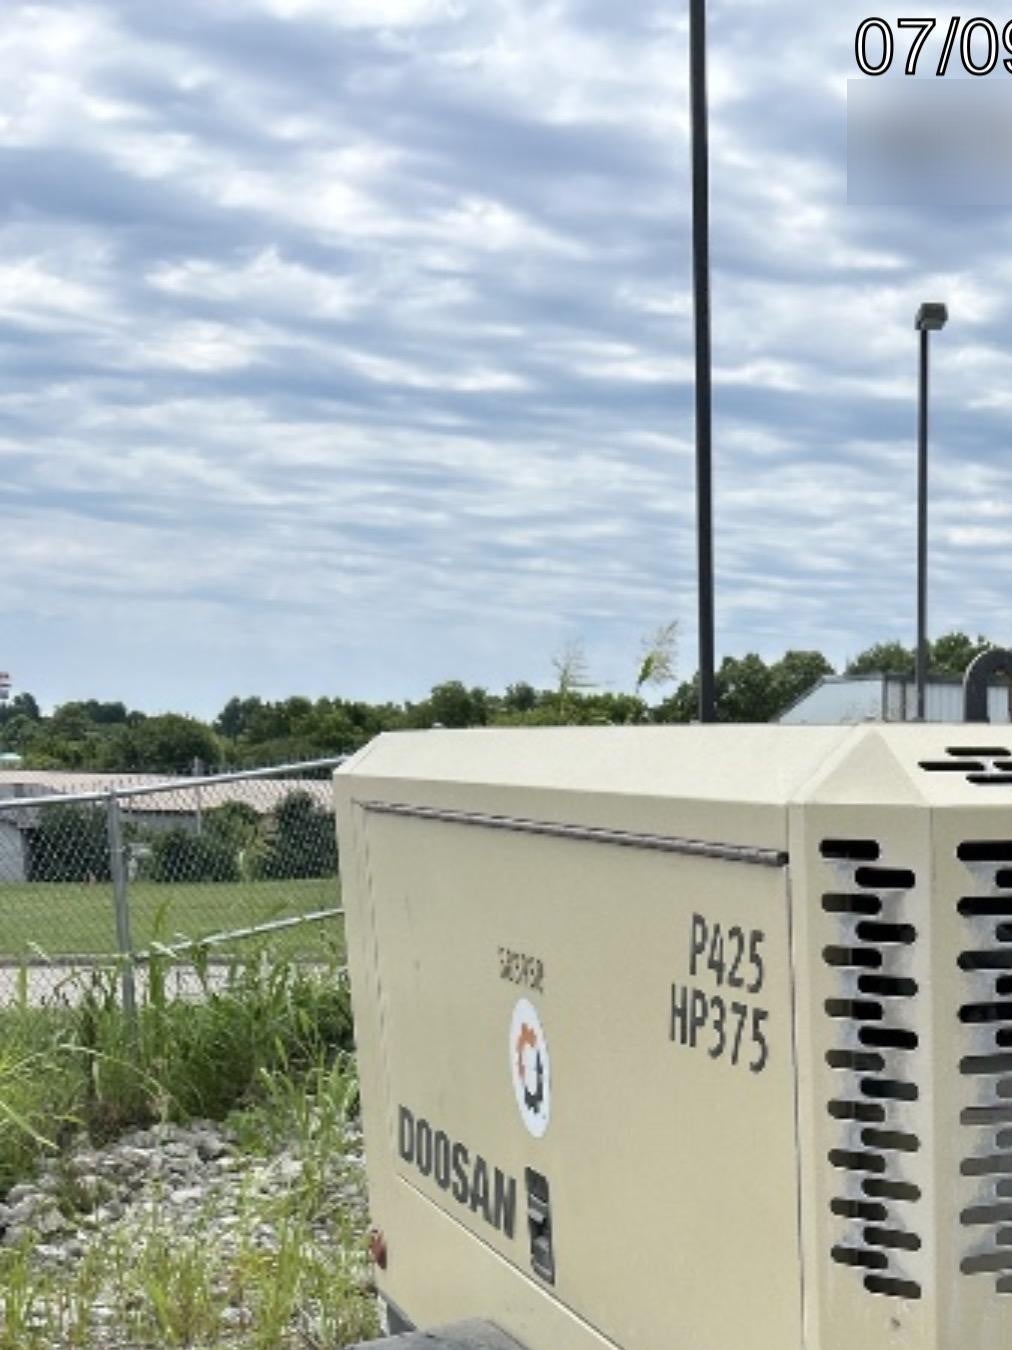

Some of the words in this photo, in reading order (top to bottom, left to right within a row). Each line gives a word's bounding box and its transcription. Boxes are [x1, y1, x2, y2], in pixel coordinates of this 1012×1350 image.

[688, 911, 766, 995] P425
[669, 982, 770, 1074] HP375
[398, 1103, 518, 1241] DOOSAN
